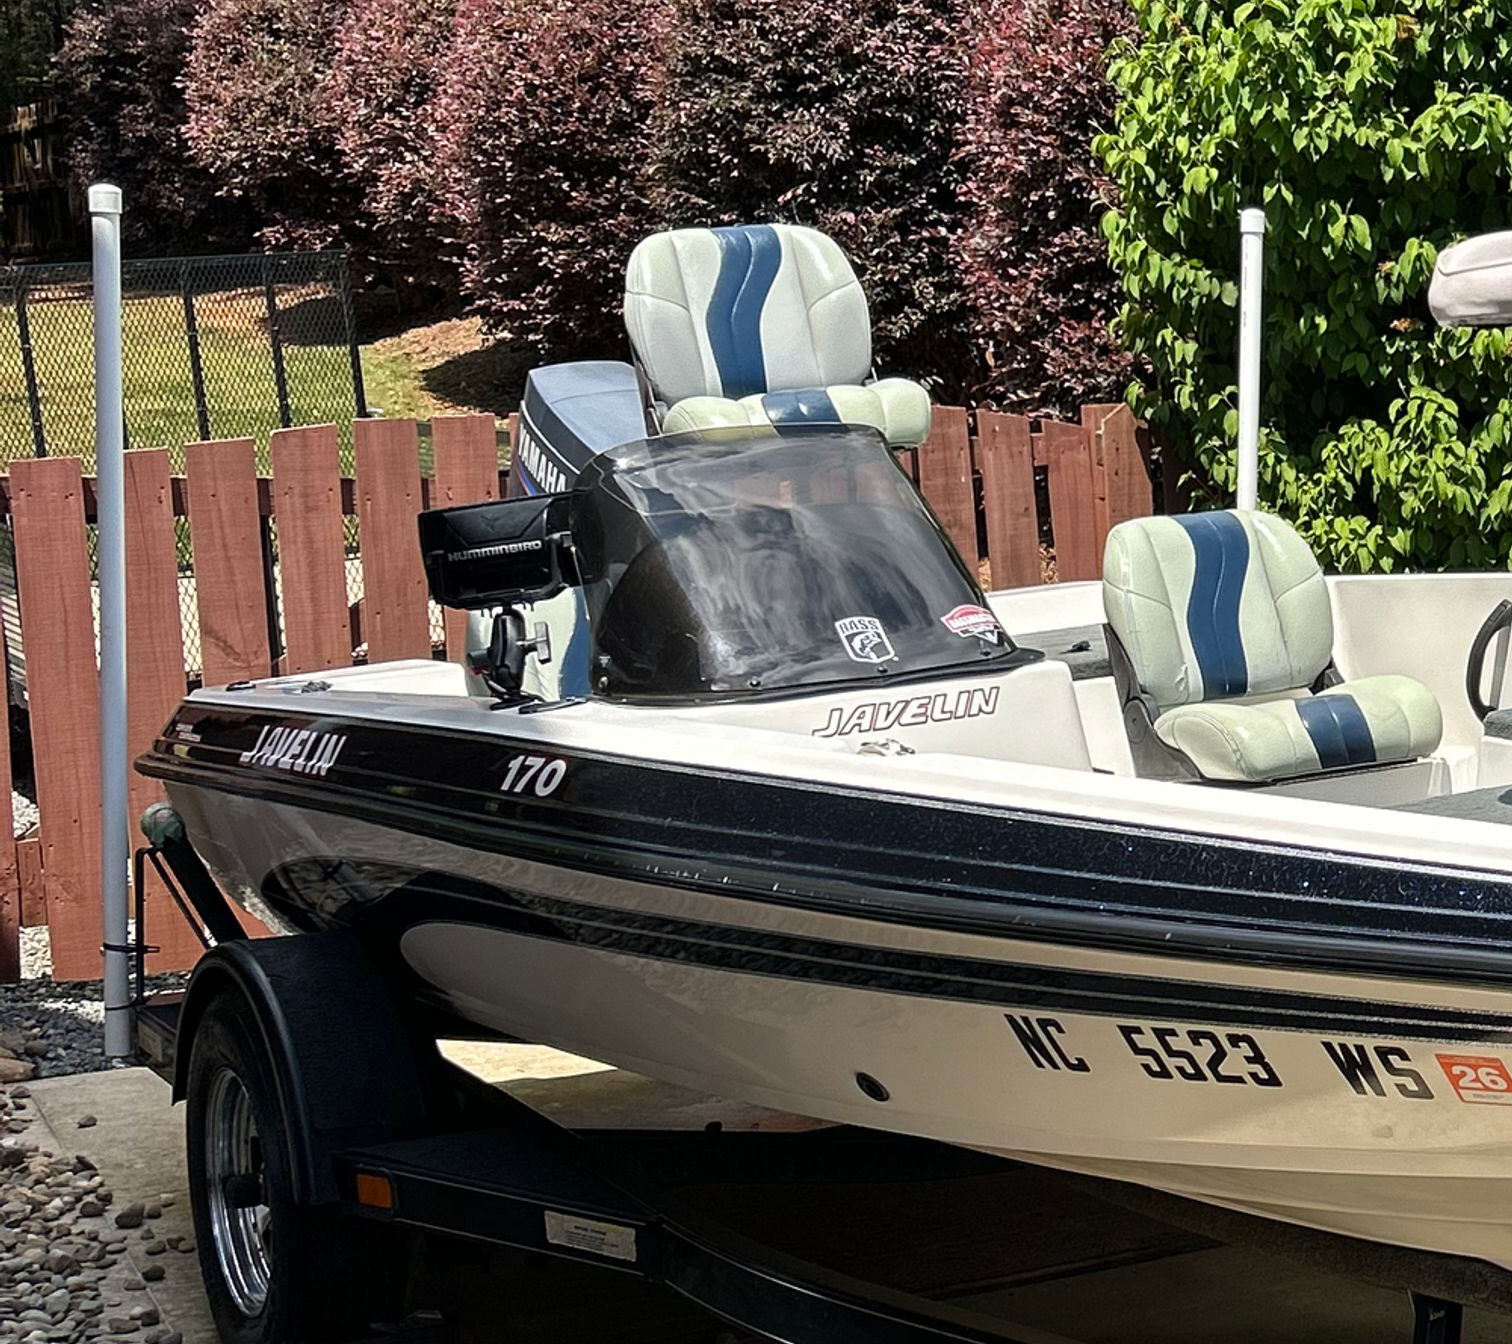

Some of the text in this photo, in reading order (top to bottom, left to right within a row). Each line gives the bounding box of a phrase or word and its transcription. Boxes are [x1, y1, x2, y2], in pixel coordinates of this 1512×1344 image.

[518, 422, 567, 493] YAMAHA
[448, 539, 543, 562] HUMMINBIRD
[811, 686, 1001, 738] JAVELIN
[239, 724, 348, 777] JAVELIN
[500, 755, 567, 797] 170
[1003, 1013, 1435, 1100] NC 5523 WS
[1451, 1064, 1509, 1091] 26
